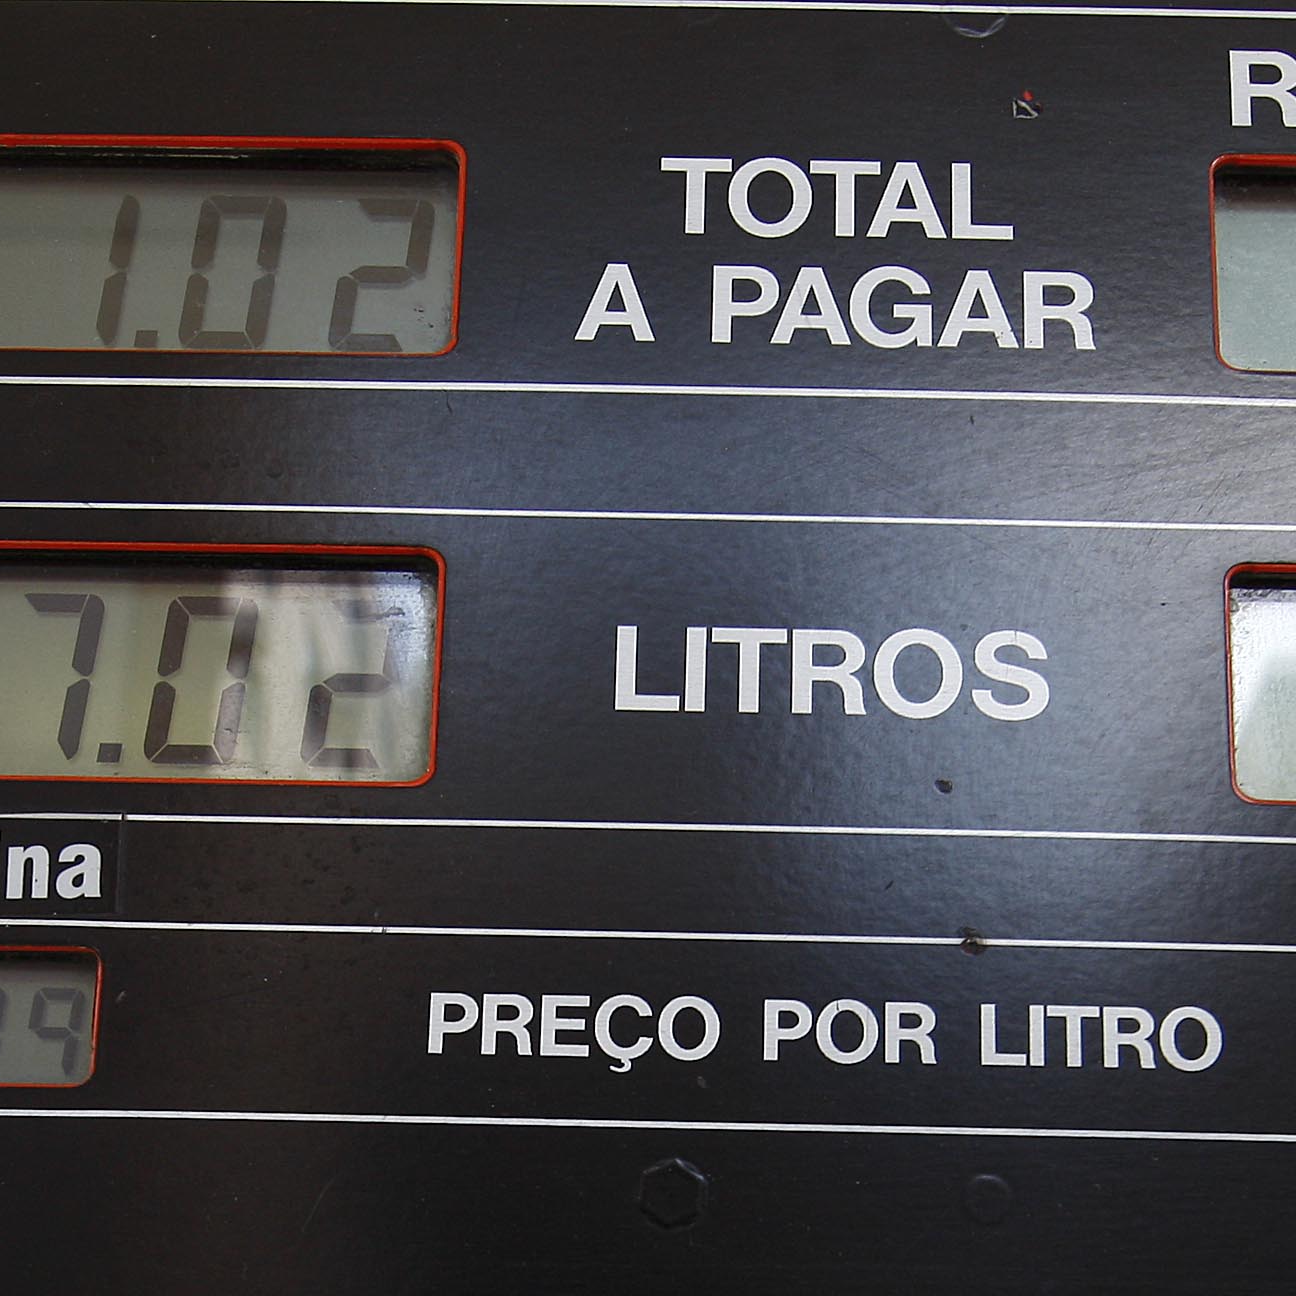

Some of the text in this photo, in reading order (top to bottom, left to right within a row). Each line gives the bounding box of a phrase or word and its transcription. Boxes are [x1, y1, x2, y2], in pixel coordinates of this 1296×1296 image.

[660, 156, 1014, 240] TOTAL
[574, 263, 1097, 350] A PAGAR
[614, 624, 1051, 720] LITROS
[427, 991, 1224, 1073] PREÇO POR LITRO
